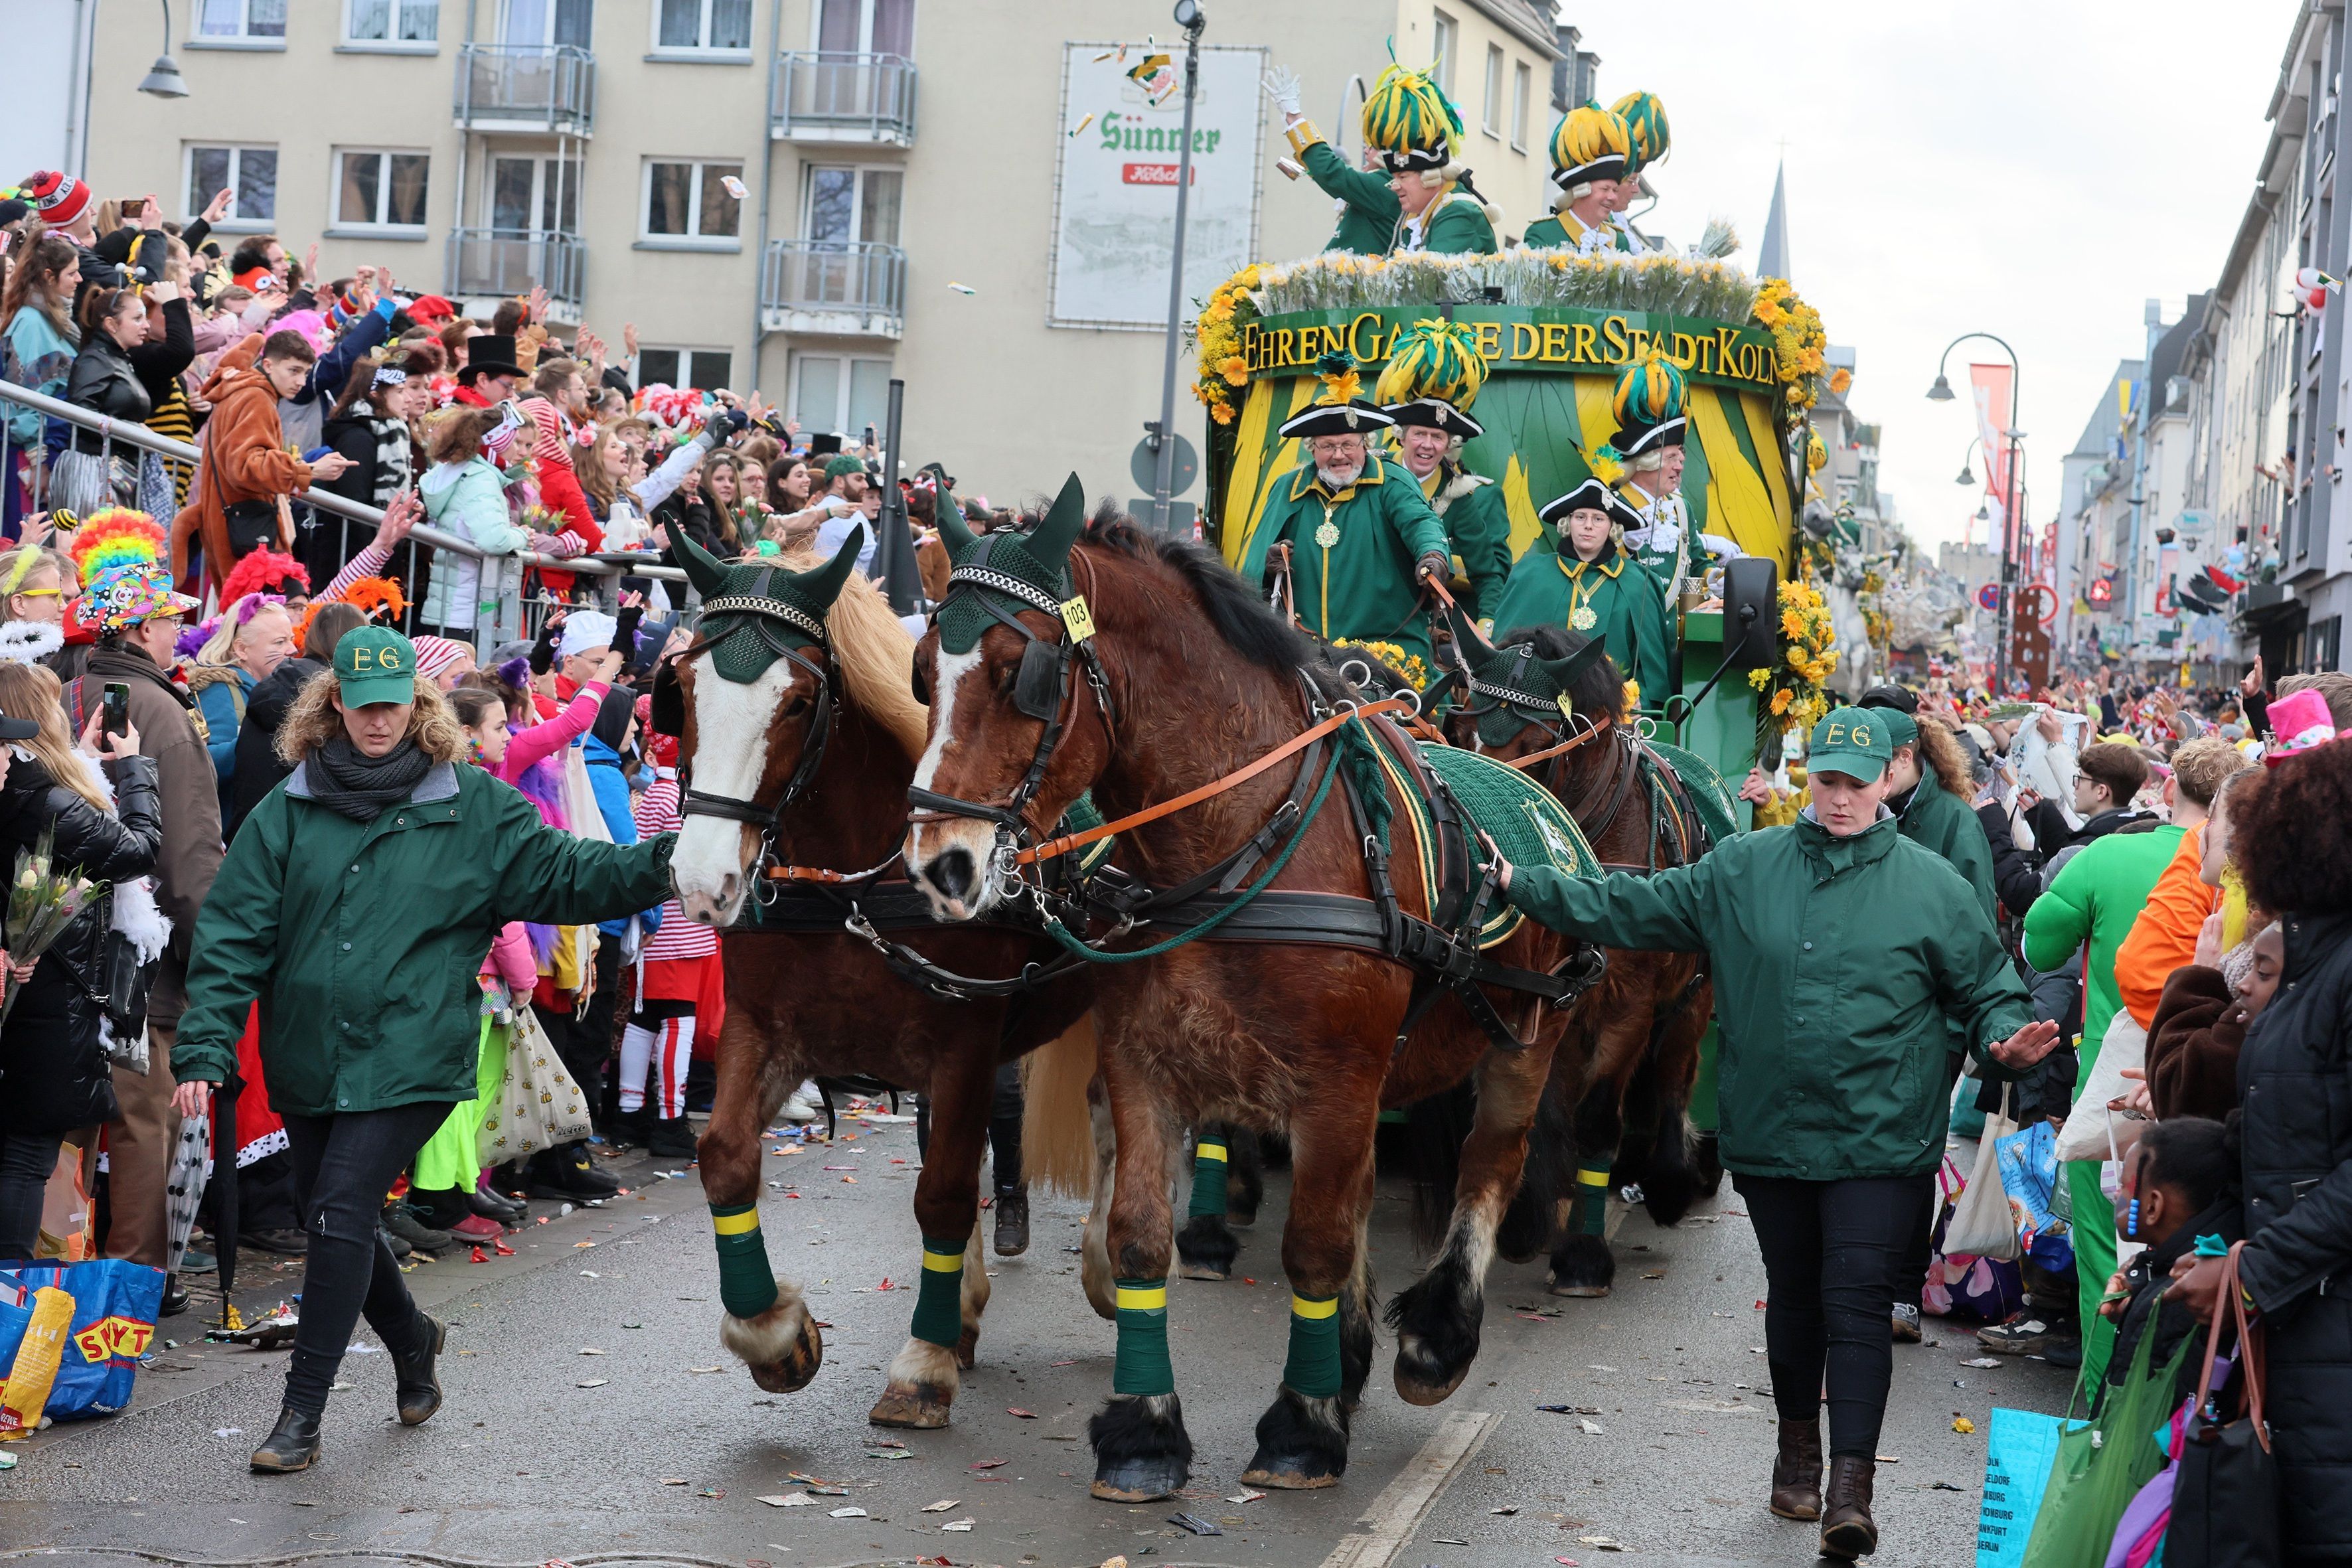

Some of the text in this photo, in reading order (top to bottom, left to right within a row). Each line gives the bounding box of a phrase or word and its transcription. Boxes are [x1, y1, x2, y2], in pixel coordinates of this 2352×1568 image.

[1100, 110, 1221, 153] Sünner
[1066, 603, 1086, 627] 103
[557, 1124, 588, 1136] Netto
[1, 1413, 19, 1427] REWE
